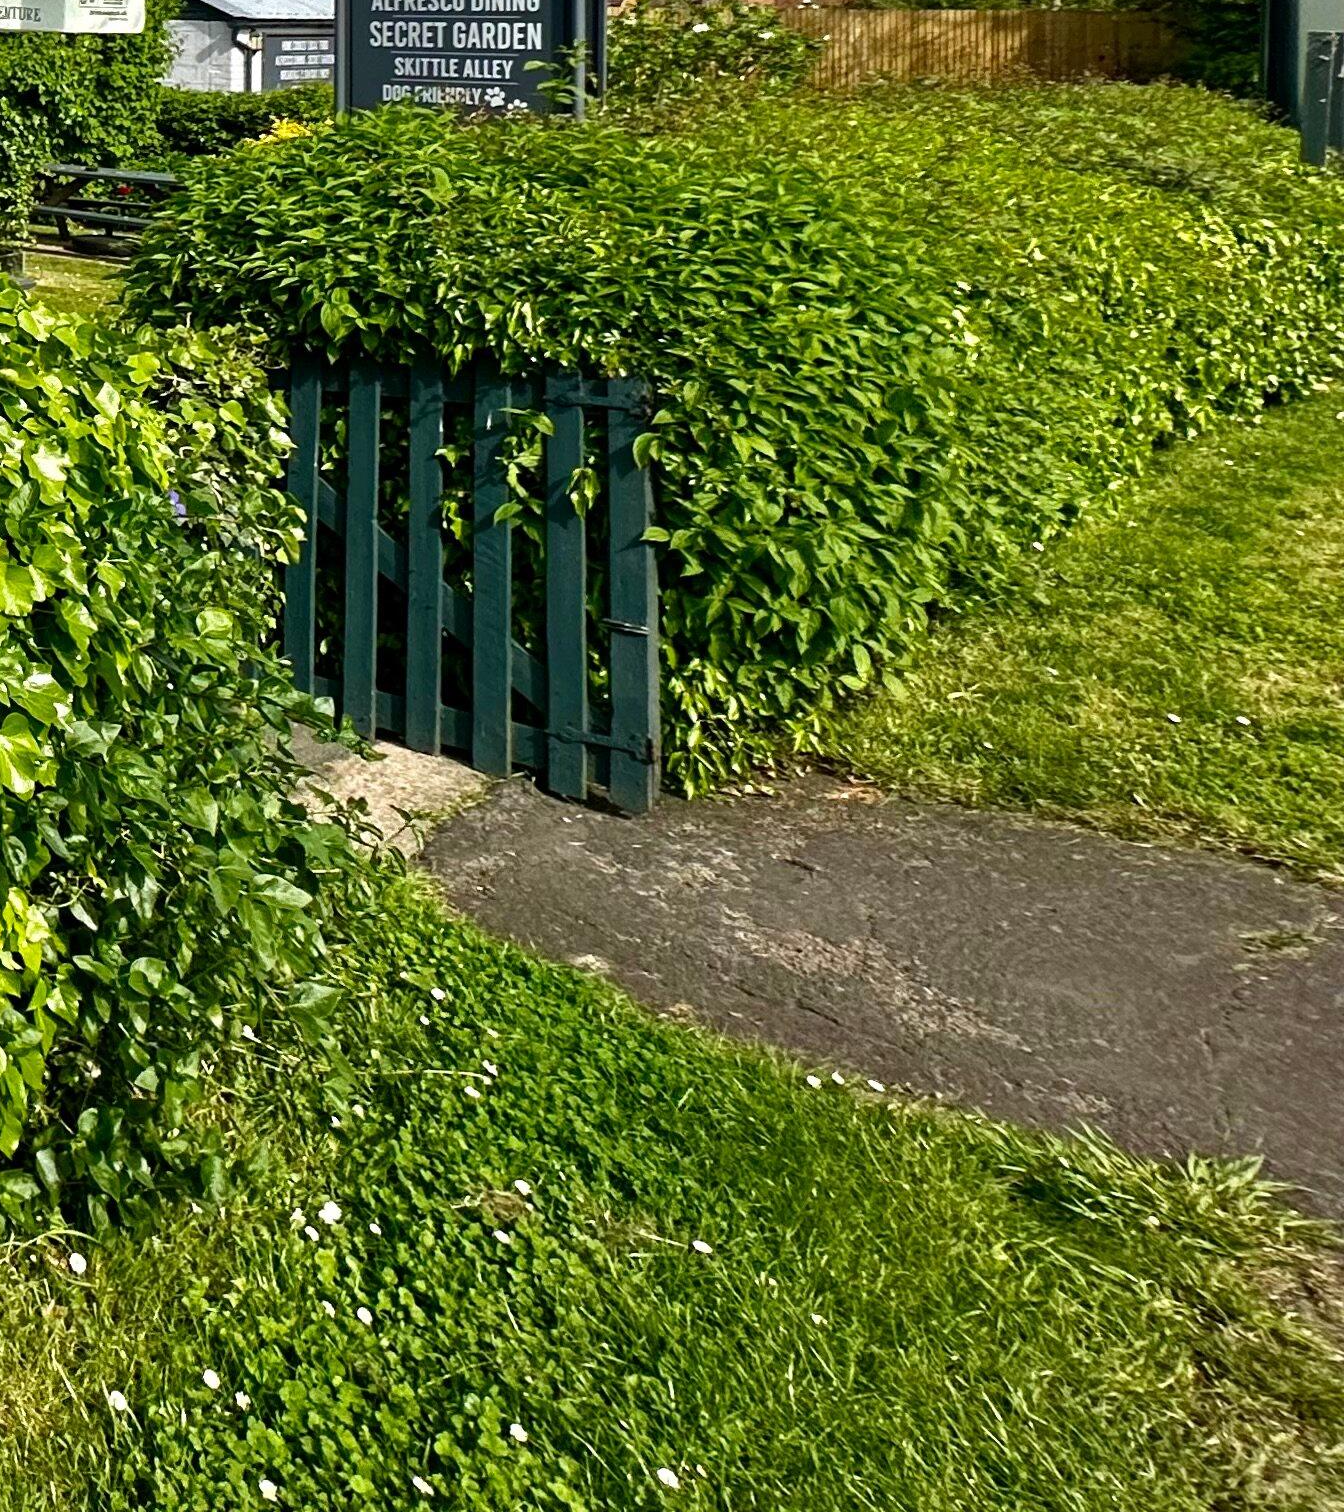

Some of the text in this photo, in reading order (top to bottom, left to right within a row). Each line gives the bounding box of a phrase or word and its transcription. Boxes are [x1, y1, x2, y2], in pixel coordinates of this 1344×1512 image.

[368, 20, 543, 50] SECRET GARDEN
[393, 56, 514, 80] SKITTLE ALLEY
